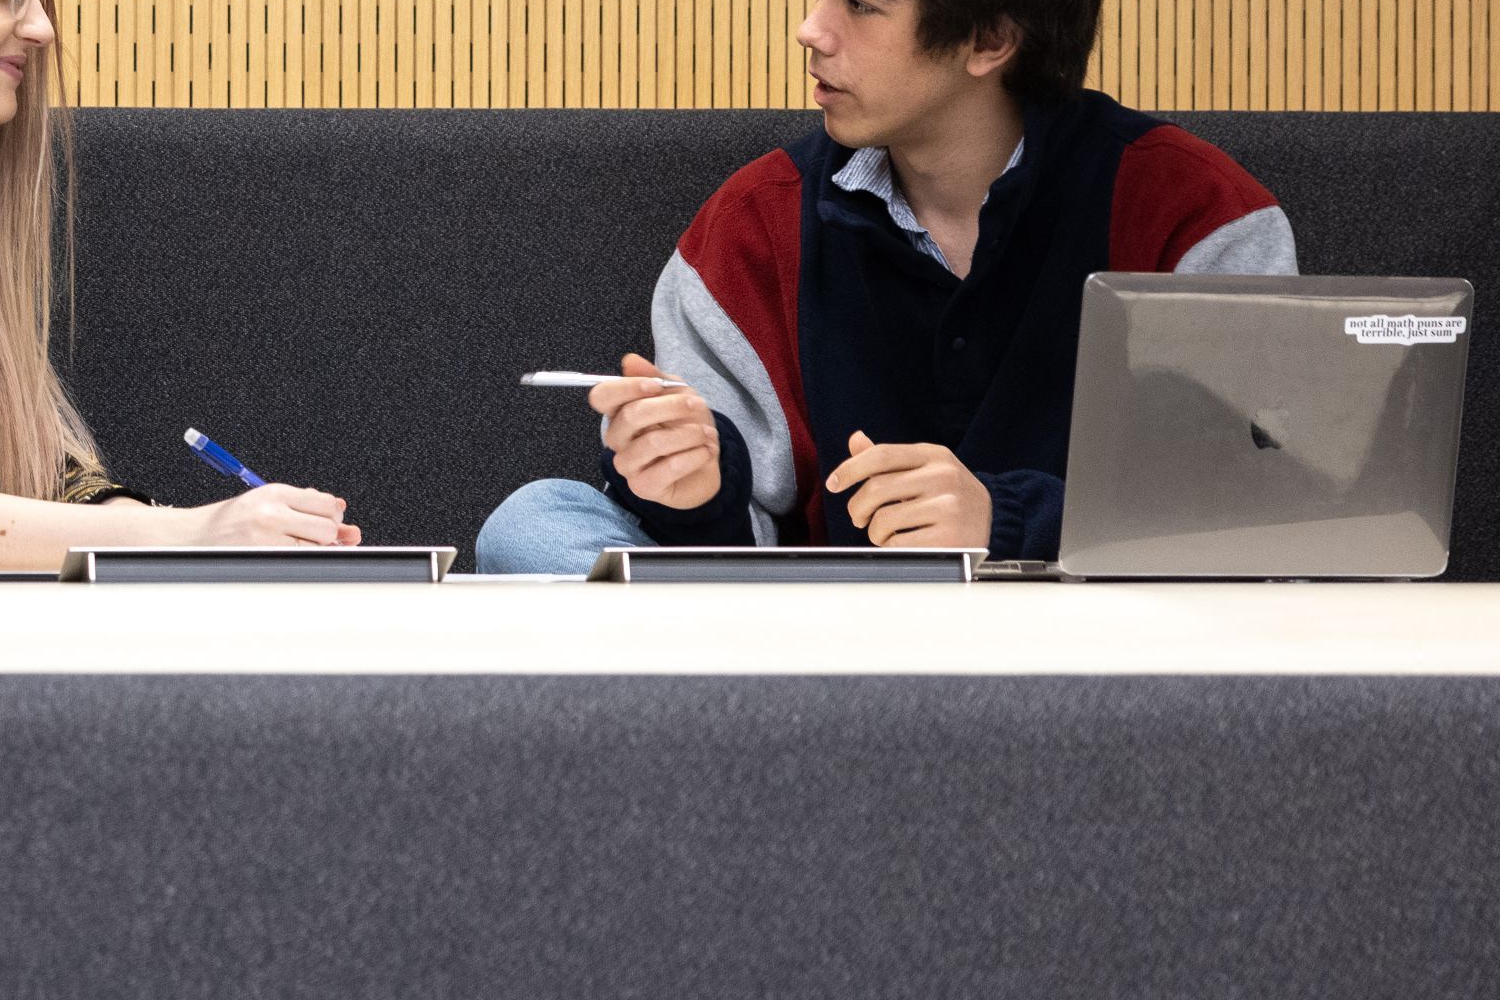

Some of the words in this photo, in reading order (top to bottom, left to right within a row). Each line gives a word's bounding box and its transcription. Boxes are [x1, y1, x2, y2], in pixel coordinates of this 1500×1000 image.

[1350, 319, 1367, 328] not
[1370, 318, 1384, 328] all
[1387, 318, 1414, 328] math
[1417, 320, 1443, 330] puns
[1445, 320, 1462, 328] are
[1361, 328, 1405, 338] terrible,
[1408, 328, 1428, 339] just
[1430, 329, 1452, 337] sum
